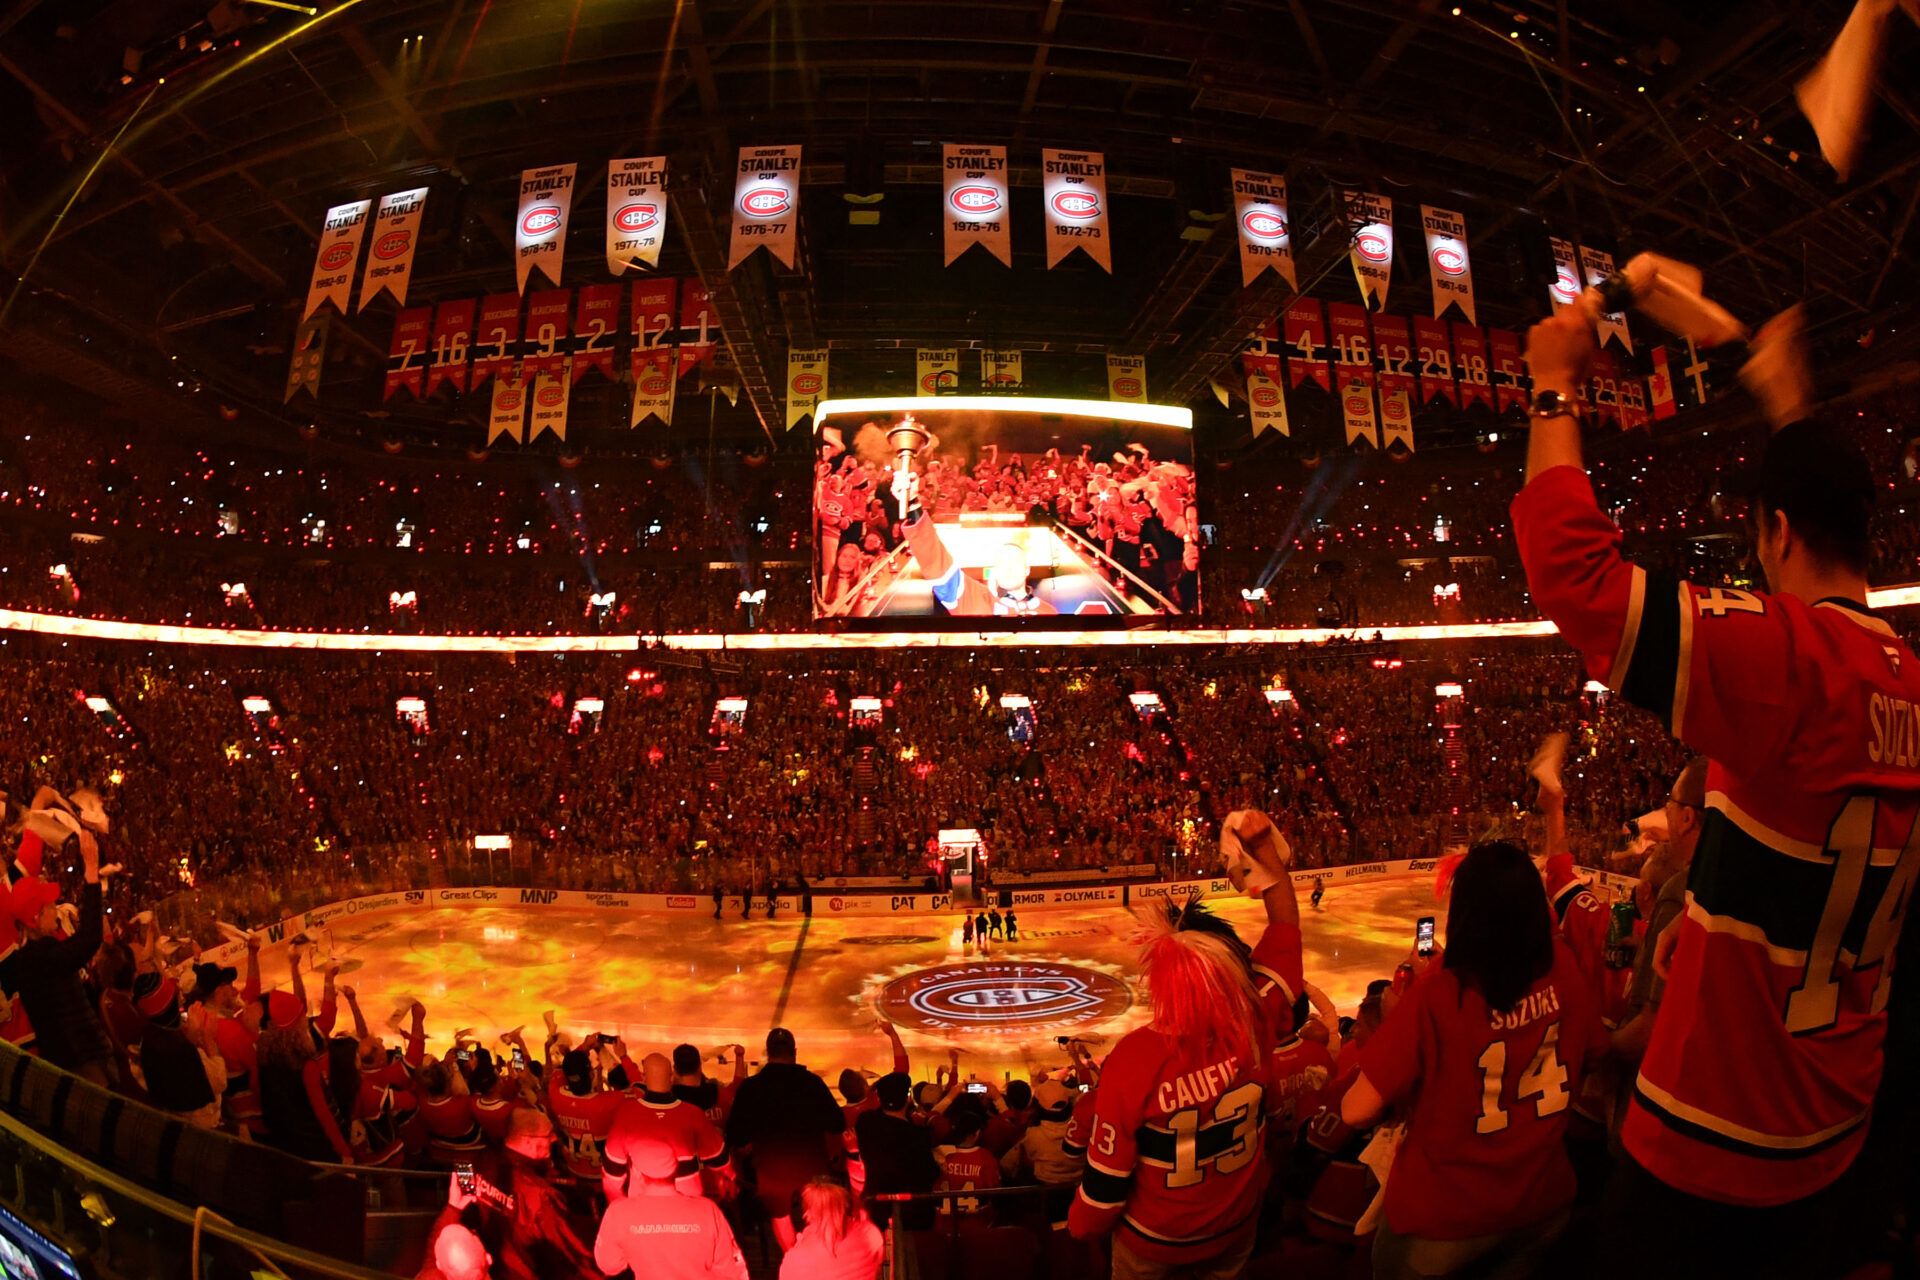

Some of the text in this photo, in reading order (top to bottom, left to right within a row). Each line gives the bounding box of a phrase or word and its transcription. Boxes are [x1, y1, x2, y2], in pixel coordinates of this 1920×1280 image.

[754, 149, 787, 157] COUPE
[959, 148, 992, 156] COUPE
[1058, 153, 1089, 163] COUPE
[623, 160, 654, 171] COUPE
[740, 157, 799, 172] STANLEY
[946, 156, 1005, 171] STANLEY
[1046, 160, 1102, 177] STANLEY
[535, 168, 563, 179] COUPE
[610, 171, 665, 188] STANLEY
[758, 172, 778, 181] CUP
[965, 171, 986, 179] CUP
[1065, 177, 1084, 185] CUP
[1243, 173, 1273, 185] COUPE
[521, 175, 573, 195] STANLEY
[628, 187, 647, 197] CUP
[1234, 180, 1286, 199] STANLEY
[391, 193, 416, 205] COUPE
[535, 191, 553, 201] CUP
[378, 200, 424, 220] STANLEY
[325, 212, 367, 232] STANLEY
[390, 216, 406, 226] CUP
[952, 221, 1001, 233] 1975-76
[1424, 216, 1464, 237] STANLEY
[335, 228, 350, 238] CUP
[739, 224, 787, 235] 1976-77
[1055, 225, 1101, 239] 1972-73
[520, 241, 557, 257] 1978-79
[614, 237, 656, 251] 1977-78
[1246, 244, 1290, 258] 1970-71
[1583, 256, 1616, 275] STANLEY
[1436, 278, 1469, 295] 1967-68
[586, 317, 606, 354] 2
[633, 312, 671, 353] 12
[696, 309, 711, 347] 1
[487, 326, 507, 362] 3
[536, 322, 557, 358] 9
[1296, 329, 1318, 364] 4
[400, 338, 418, 372] 7
[433, 330, 469, 368] 16
[1336, 333, 1370, 366] 16
[790, 352, 827, 363] STANLEY
[918, 351, 956, 363] STANLEY
[983, 353, 1020, 363] STANLEY
[1108, 357, 1143, 369] STANLEY
[1379, 343, 1415, 378] 12
[1420, 346, 1453, 380] 29
[1460, 352, 1488, 386] 18
[1502, 358, 1518, 390] 5
[1294, 871, 1334, 882] CFMOTO
[1139, 883, 1200, 898] Uber Eats
[1211, 880, 1230, 893] Bell
[404, 891, 424, 902] SN
[440, 889, 498, 900] Great Clips
[520, 889, 558, 904] MNP
[586, 893, 613, 902] sports
[1011, 893, 1046, 906] RMOR
[1063, 890, 1107, 902] OLYMEL
[358, 898, 399, 911] Desjardins
[891, 896, 916, 911] CAT
[931, 895, 951, 910] CA
[1785, 795, 1920, 1034] 14
[918, 965, 1064, 985] CANADIENS
[1490, 984, 1560, 1031] SUZUKI
[920, 1018, 958, 1030] DE
[1475, 1020, 1571, 1134] 14
[1089, 1112, 1117, 1156] 13
[1165, 1080, 1264, 1188] 13
[568, 1133, 604, 1168] 14
[940, 1180, 979, 1216] 14
